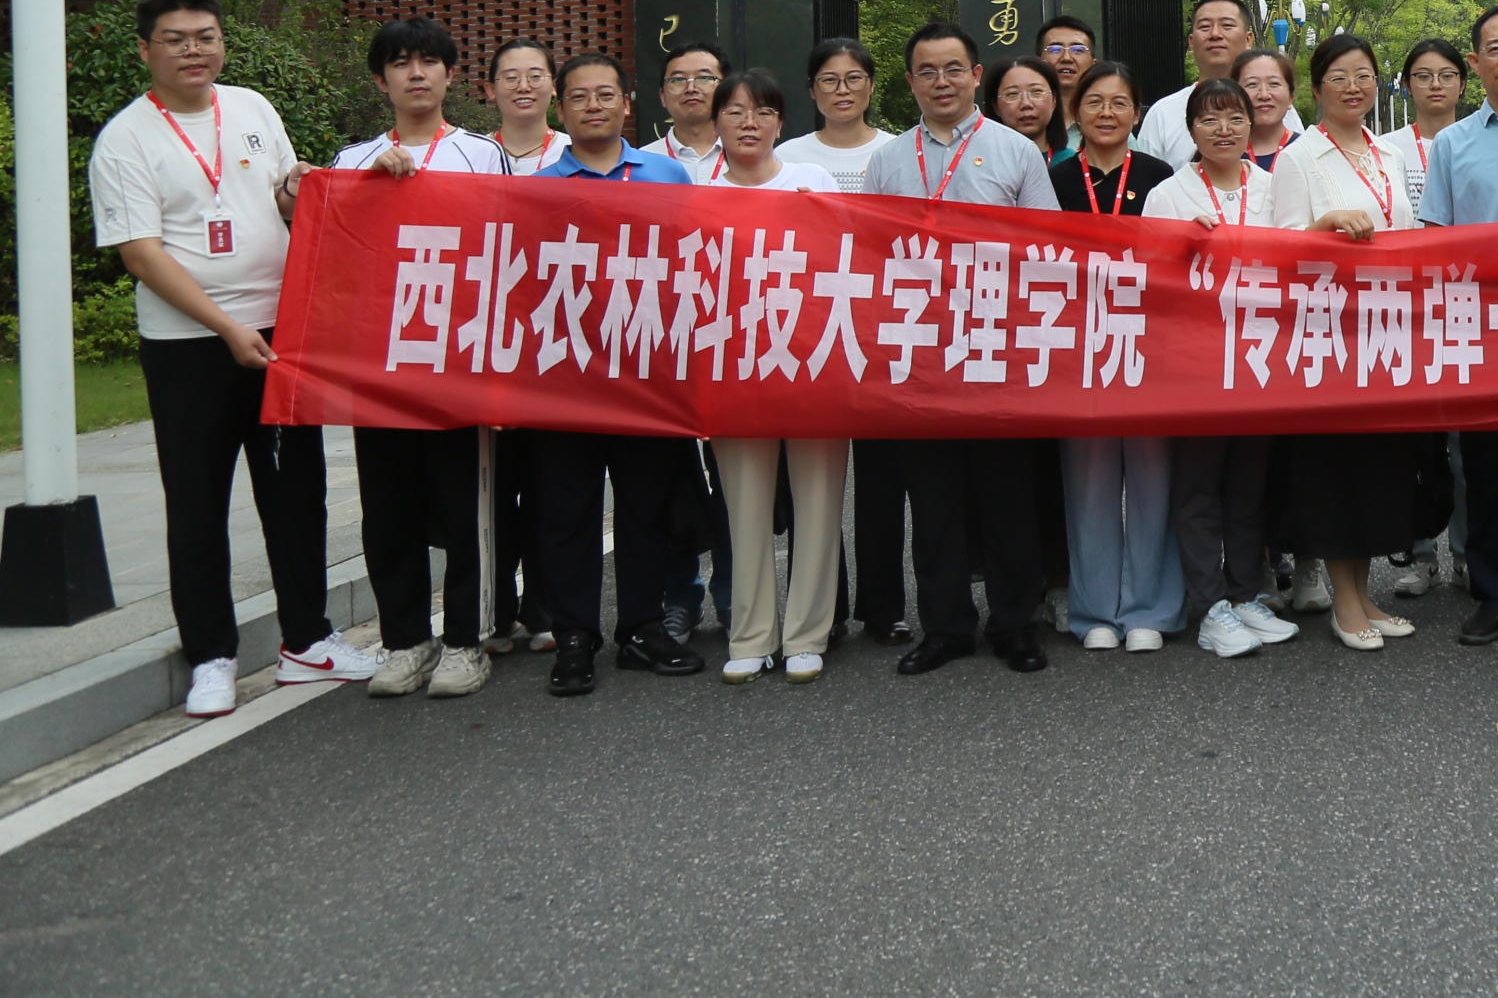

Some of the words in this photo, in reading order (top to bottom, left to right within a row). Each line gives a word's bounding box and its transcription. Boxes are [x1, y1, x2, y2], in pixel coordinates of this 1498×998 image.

[385, 221, 1147, 389] 西北农林科技大学理学院
